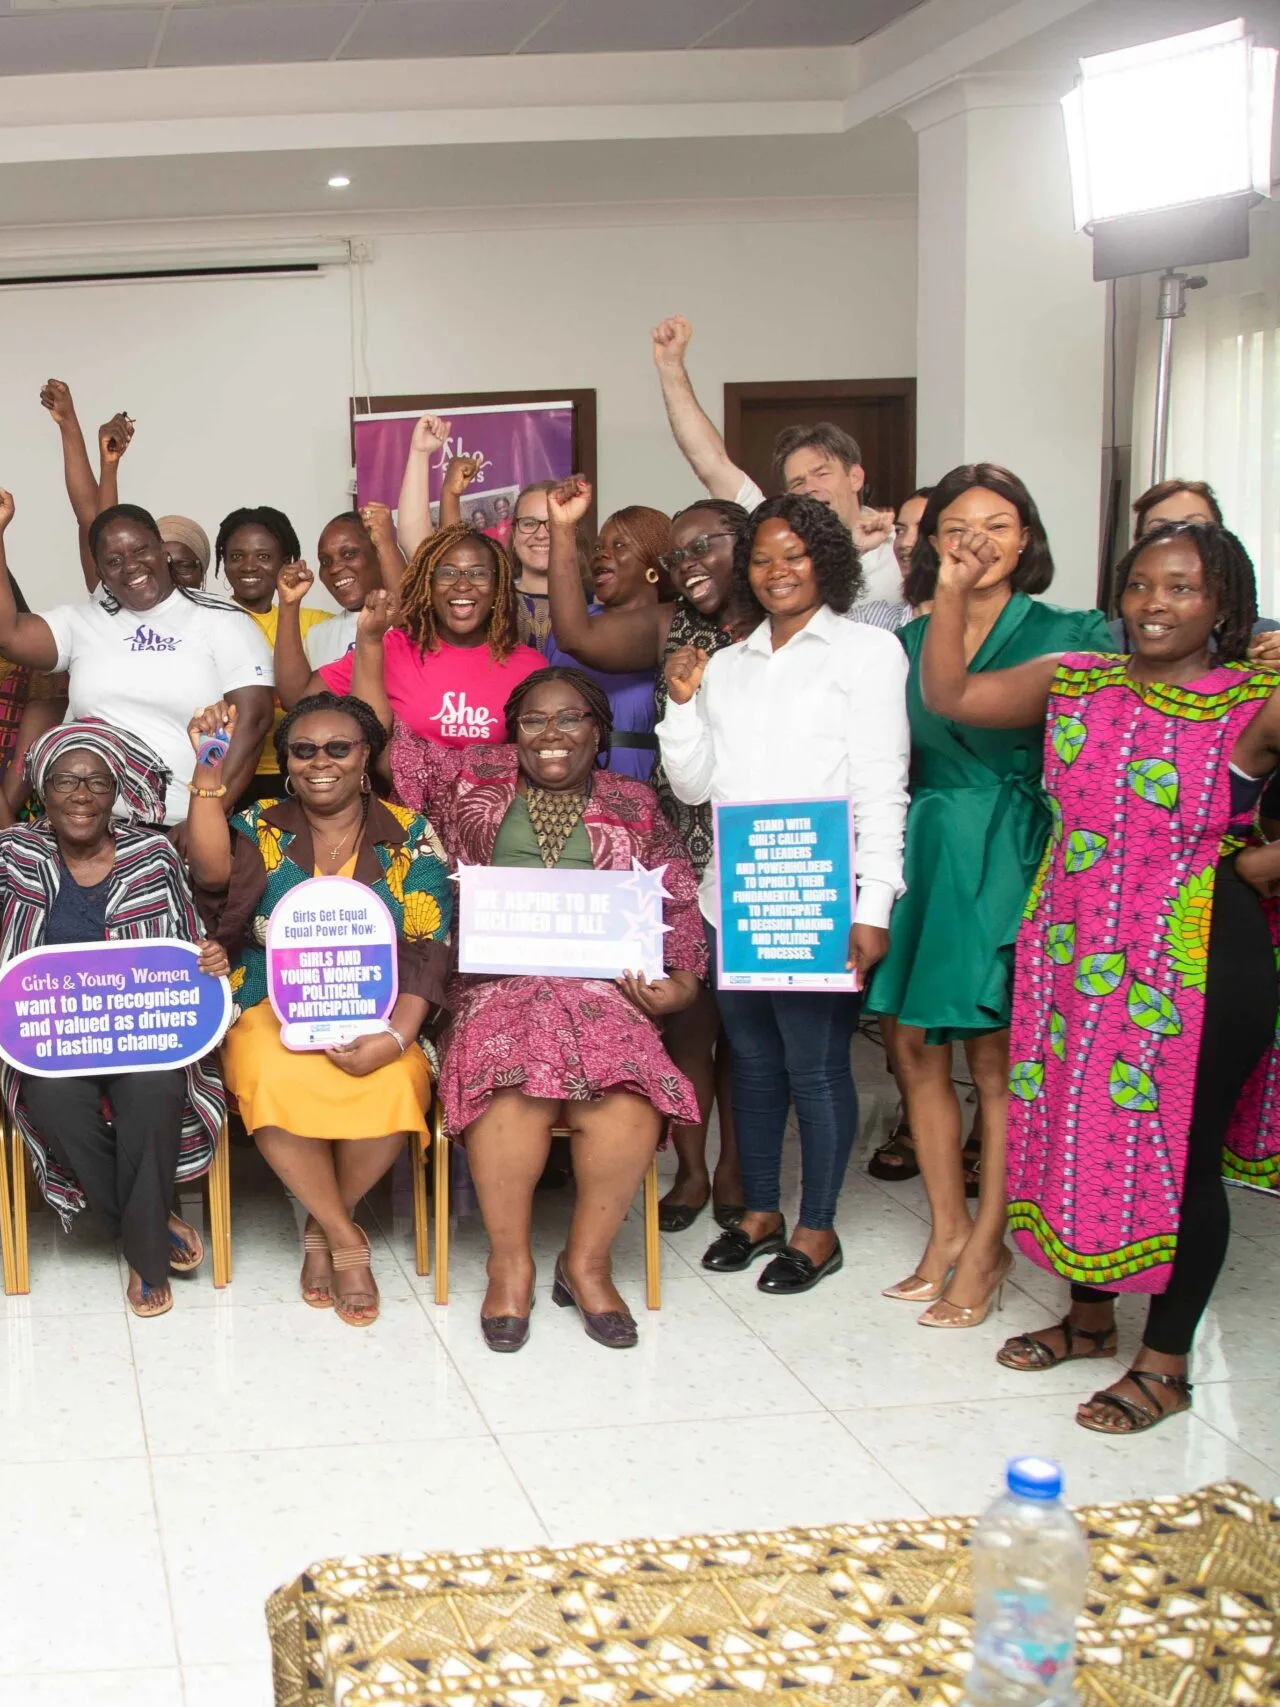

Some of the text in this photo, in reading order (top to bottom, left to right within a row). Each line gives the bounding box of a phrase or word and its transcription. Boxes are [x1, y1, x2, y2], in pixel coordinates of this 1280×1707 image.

[429, 691, 498, 725] She
[440, 724, 490, 738] LEADS
[754, 818, 811, 831] STAND WITH
[749, 832, 817, 846] GIRLS CALLING
[755, 847, 811, 859] ON LEADERS
[744, 875, 824, 888] TO UPHOLD THEIR
[293, 908, 367, 923] Girls Get Equal
[748, 904, 822, 916] TO PARTICIPATE
[285, 923, 376, 938] Equal Power Now:
[299, 950, 361, 967] GIRLS AND
[21, 968, 190, 992] Girls & Young Women
[281, 966, 381, 985] YOUNG WOMEN'S
[302, 983, 361, 1000] POLITICAL
[15, 987, 200, 1016] want to be recognised
[289, 999, 376, 1017] PARTICIPATION
[20, 1010, 197, 1038] and valued as drivers
[36, 1032, 182, 1058] of lasting change.
